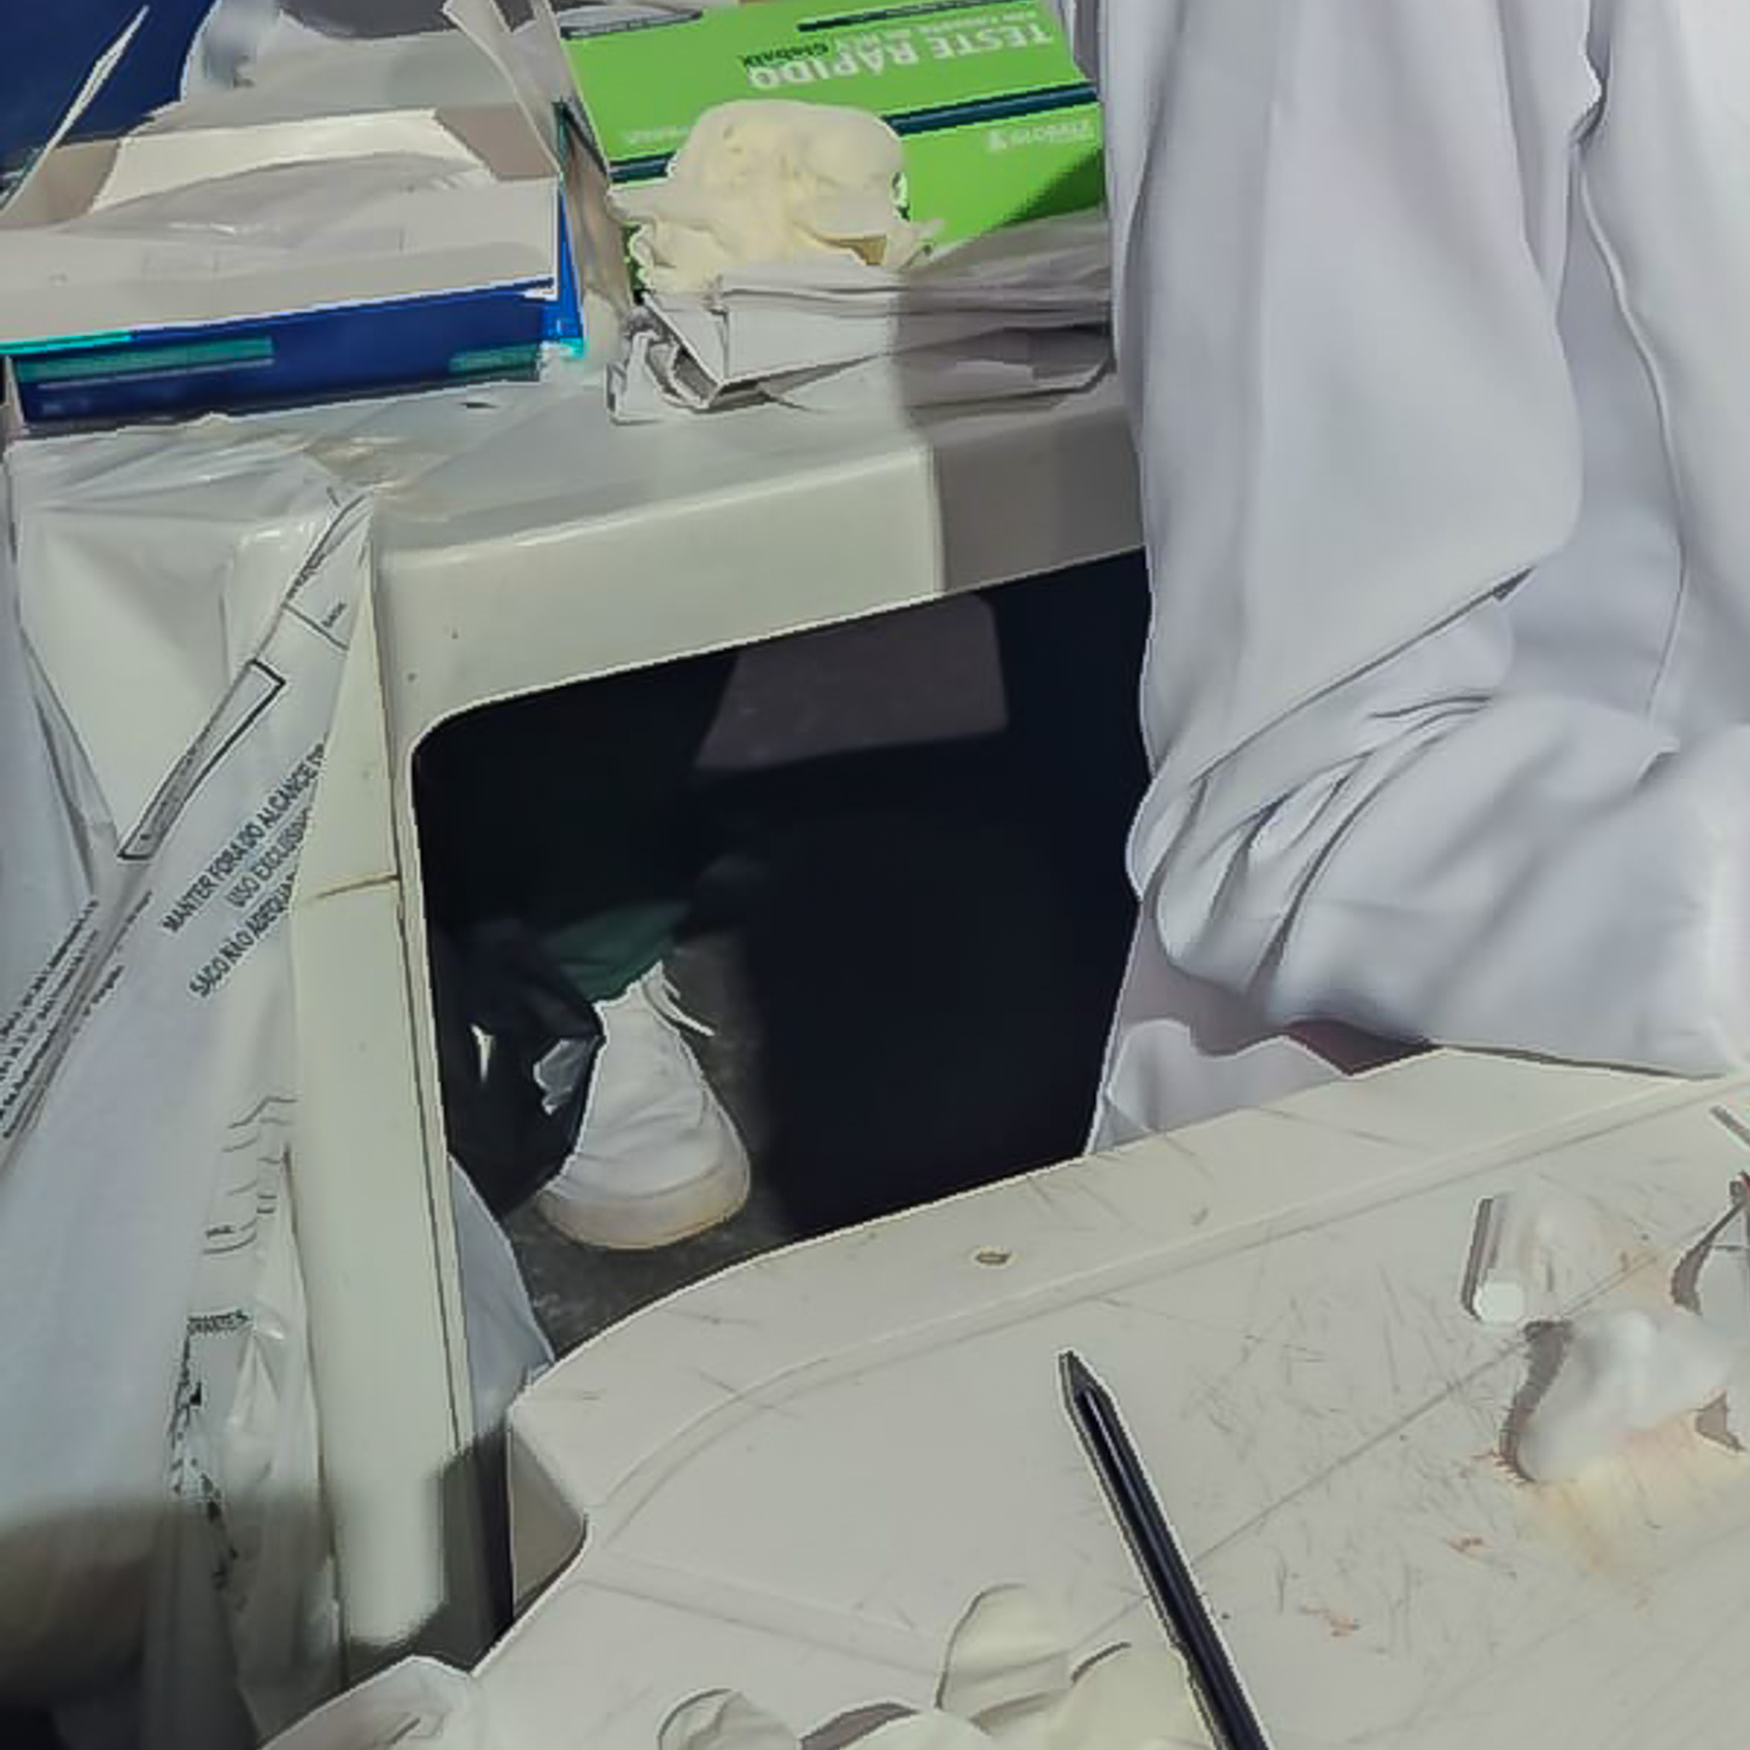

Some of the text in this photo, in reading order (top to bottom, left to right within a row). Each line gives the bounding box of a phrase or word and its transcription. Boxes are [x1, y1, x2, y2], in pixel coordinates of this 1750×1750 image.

[930, 22, 1053, 61] TESTE
[748, 41, 920, 90] RÁPIDO
[163, 876, 217, 934] MANTER
[210, 842, 247, 883] FORA
[258, 764, 317, 829] ALCANCE
[228, 876, 260, 909] USO
[190, 958, 230, 998] SACO
